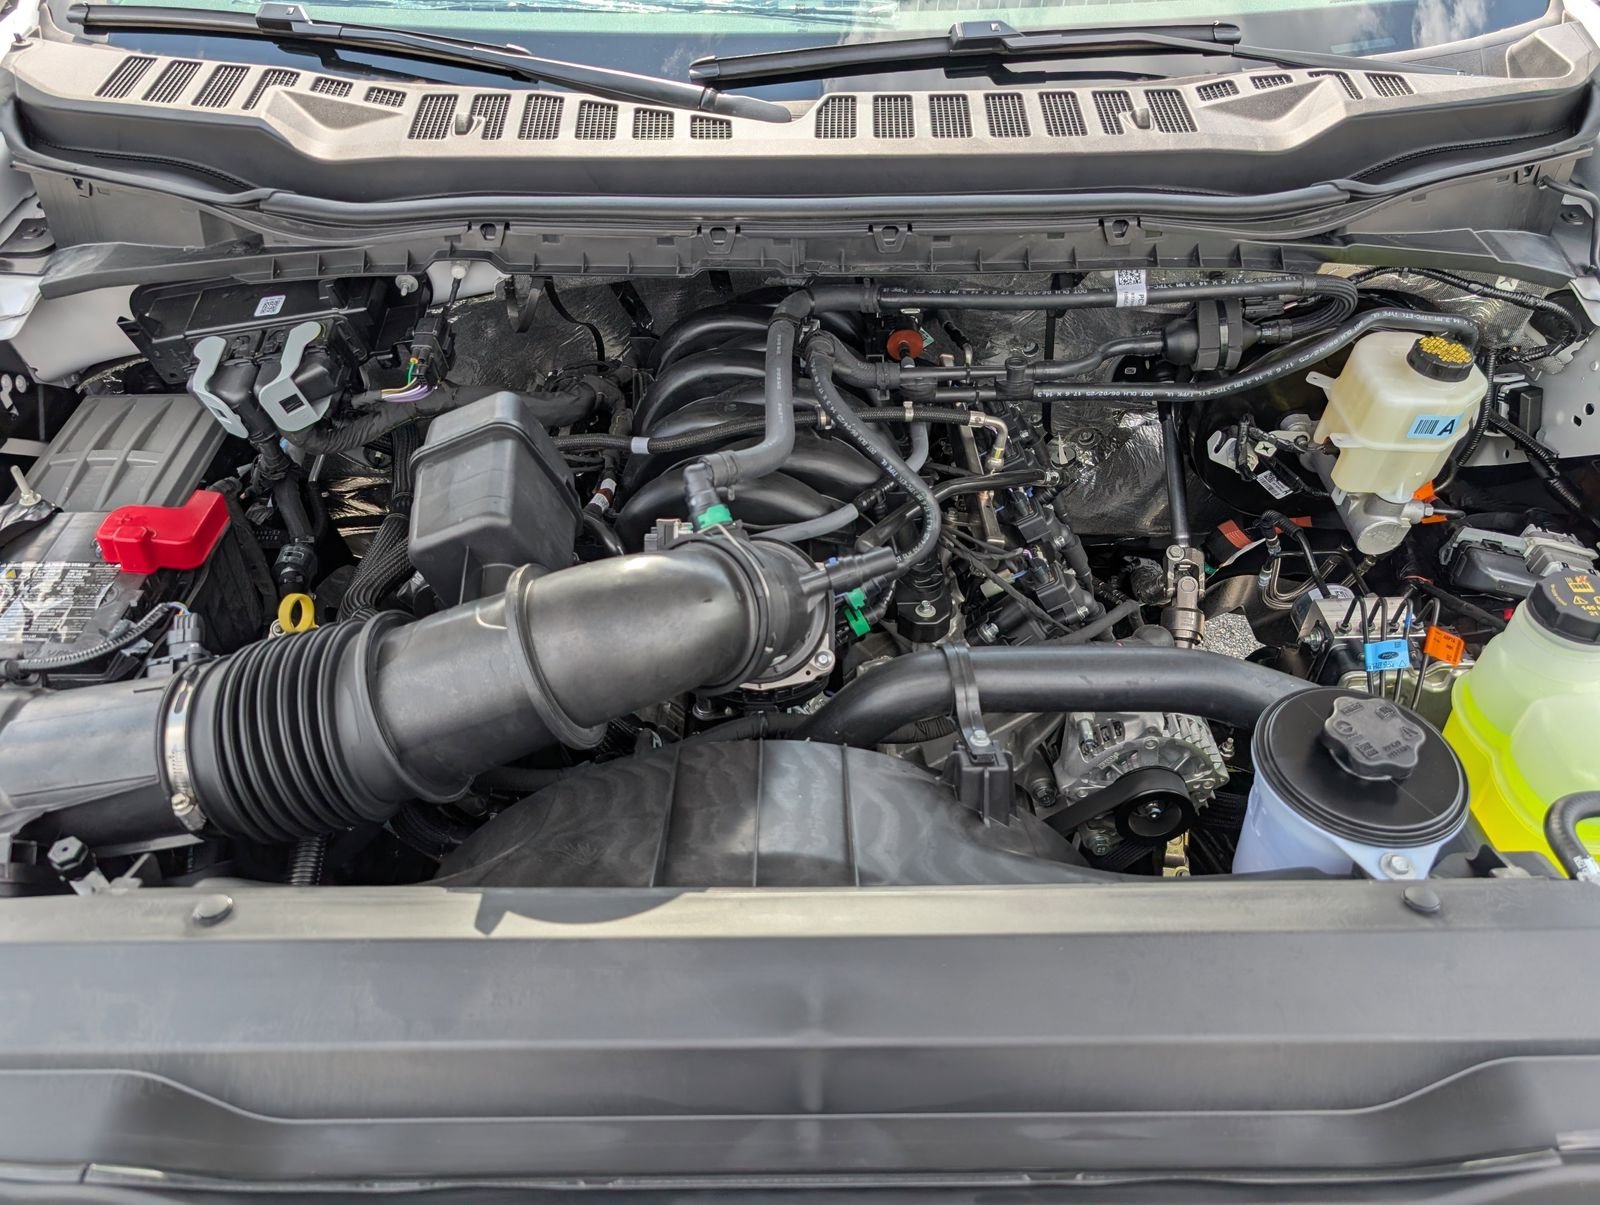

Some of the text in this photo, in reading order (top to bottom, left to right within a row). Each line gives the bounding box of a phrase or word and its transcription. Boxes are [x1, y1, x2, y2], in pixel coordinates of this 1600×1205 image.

[1275, 362, 1293, 372] 17.6
[1246, 374, 1262, 384] 14.3
[1437, 419, 1456, 436] A
[885, 464, 898, 477] TYPE
